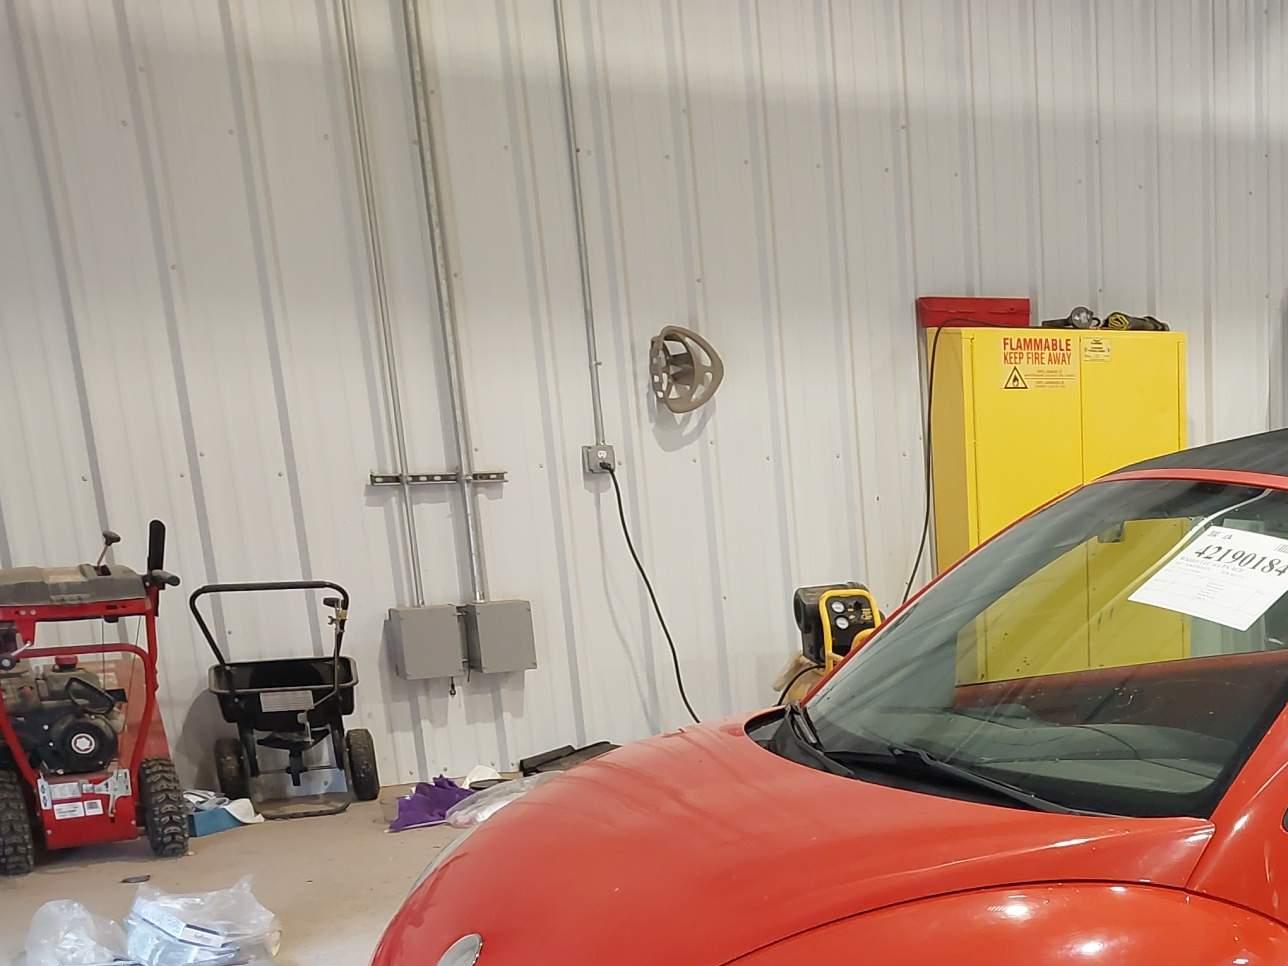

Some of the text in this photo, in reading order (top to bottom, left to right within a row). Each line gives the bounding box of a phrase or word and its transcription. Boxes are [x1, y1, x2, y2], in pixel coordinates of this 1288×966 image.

[1003, 337, 1072, 352] FLAMMABLE
[1003, 351, 1072, 365] KEEP FIRE AWAY
